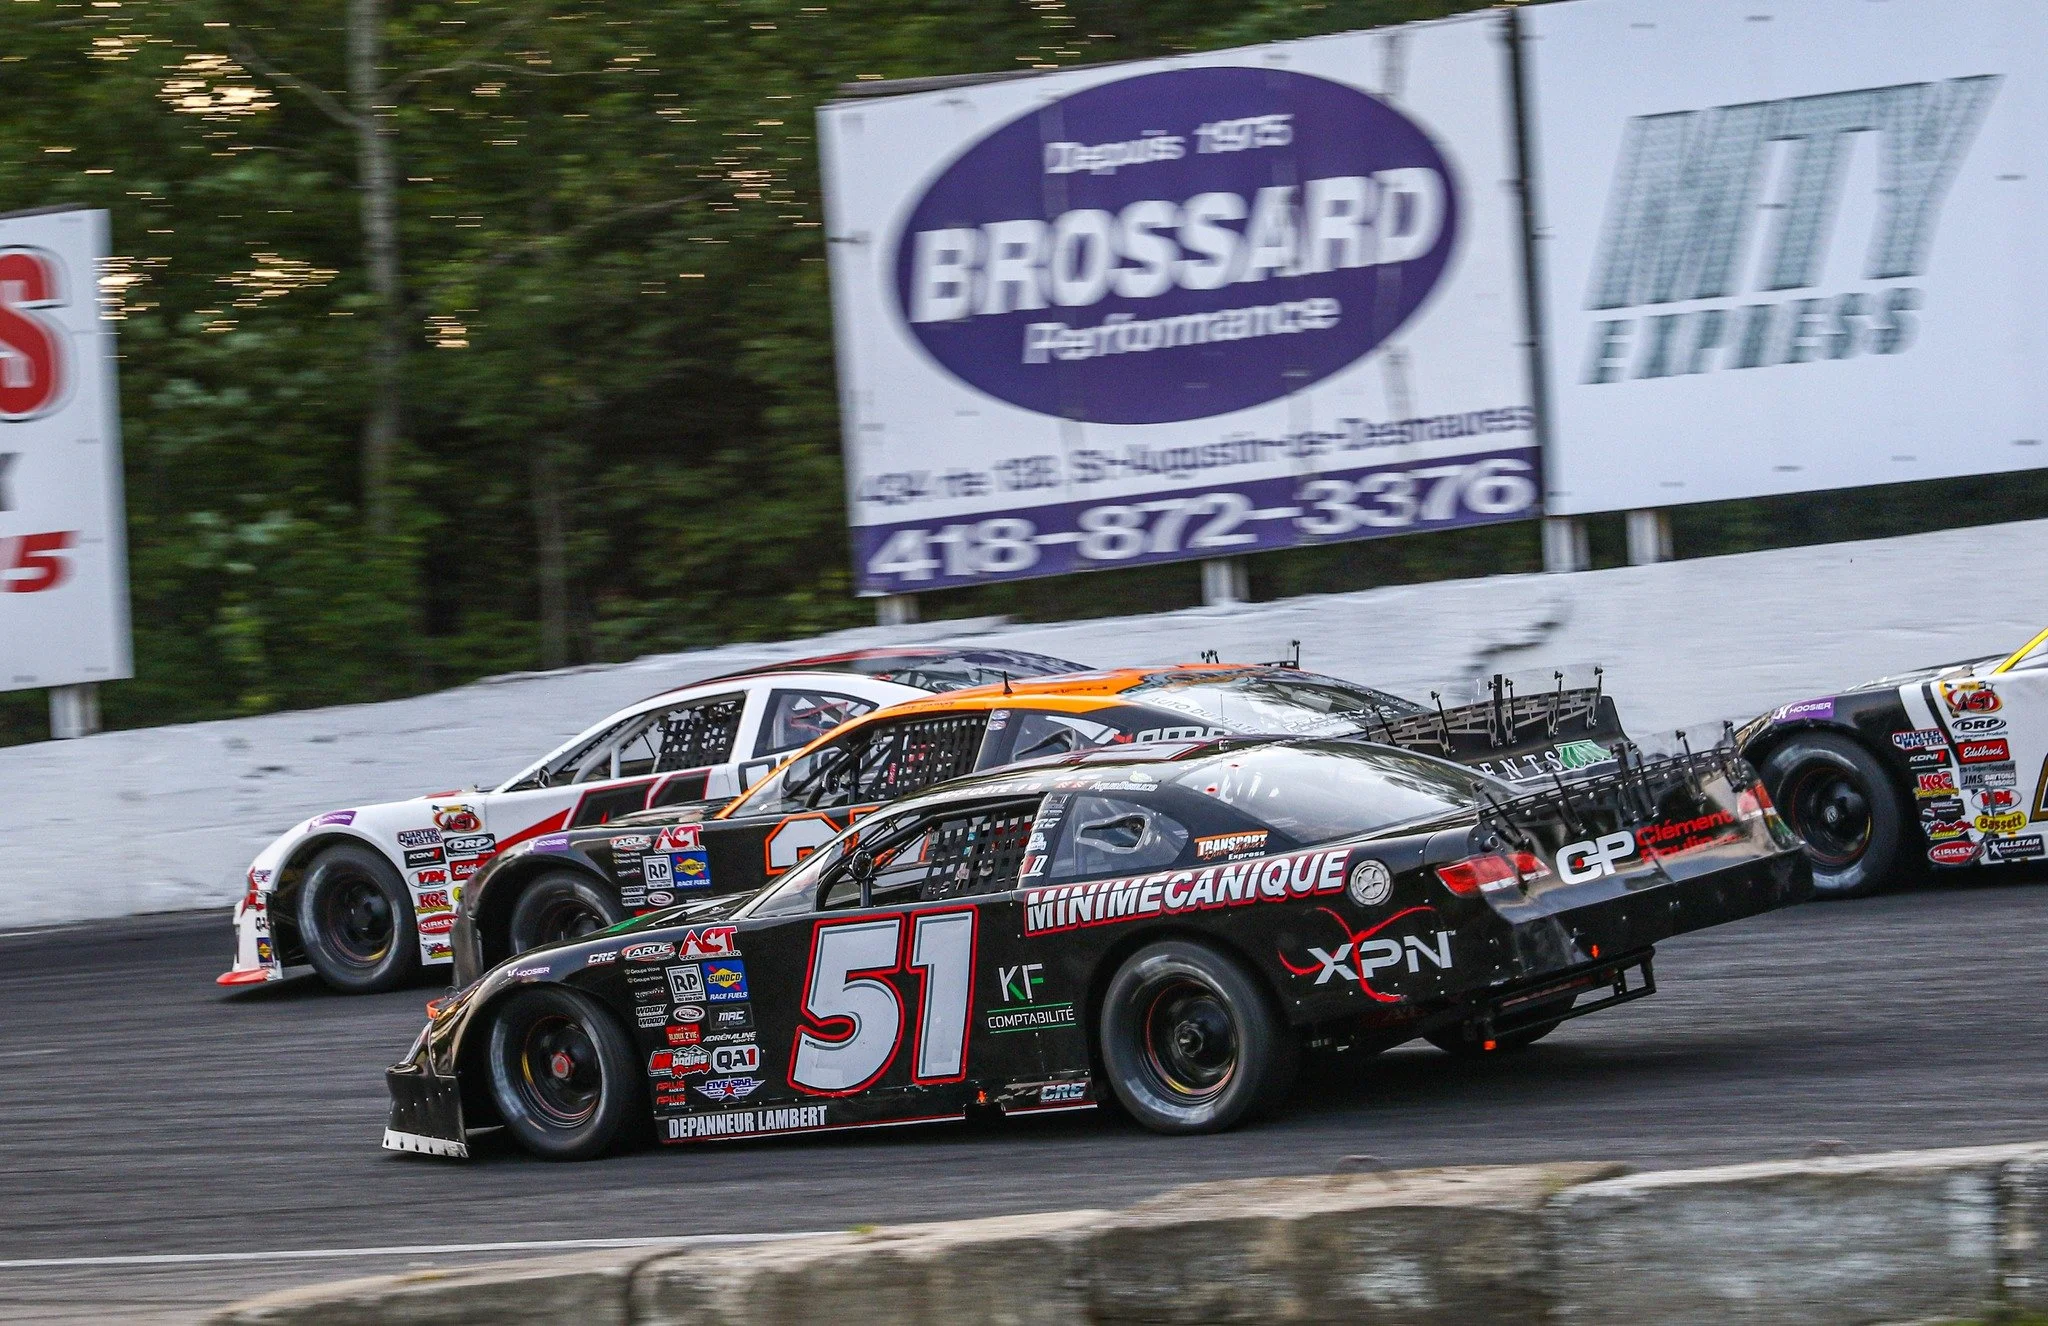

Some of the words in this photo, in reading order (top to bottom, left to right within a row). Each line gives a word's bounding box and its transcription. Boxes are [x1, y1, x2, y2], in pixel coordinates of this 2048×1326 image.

[1045, 129, 1186, 175] Depuis
[1195, 114, 1294, 154] 1975
[910, 166, 1448, 323] BROSSARD
[1023, 298, 1342, 364] Performance
[867, 458, 1536, 581] 418-872-3376
[1788, 701, 1831, 714] HOOSIER
[1961, 718, 1999, 731] DRP
[1894, 730, 1941, 744] QUARTER
[1903, 737, 1944, 749] MASTER
[1909, 753, 1939, 762] KONI
[1963, 746, 2004, 758] Edelbrock
[1918, 772, 1953, 791] KRC
[1964, 774, 1983, 785] JMS
[1635, 809, 1735, 847] Clément
[1980, 814, 2022, 831] Bassett
[454, 838, 489, 849] DRP
[1198, 834, 1268, 857] TRANSPORT
[1998, 838, 2040, 848] ALLSTAR
[409, 851, 434, 860] KONI
[1228, 851, 1266, 860] Express
[1556, 830, 1636, 885] CP
[1933, 846, 1974, 857] KIRKEY
[649, 863, 668, 880] RP
[680, 926, 738, 956] ACT
[587, 951, 618, 964] CRE
[626, 944, 672, 959] LARUE
[516, 966, 551, 977] HOOSIER
[709, 973, 741, 983] SUNOCO
[673, 973, 698, 991] RP
[998, 963, 1044, 1002] KF
[727, 991, 748, 999] FUELS
[788, 906, 978, 1096] 51
[637, 1004, 667, 1014] WOODY
[718, 1010, 745, 1021] MAC
[639, 1015, 669, 1024] WOODY
[988, 1005, 1076, 1030] COMPTABILITÉ
[717, 1048, 756, 1070] QA1
[706, 1080, 728, 1090] FIVE
[731, 1078, 752, 1087] STAR
[1041, 1082, 1086, 1100] CRE
[669, 1112, 755, 1139] DEPANNEUR
[758, 1105, 828, 1132] LAMBERT
